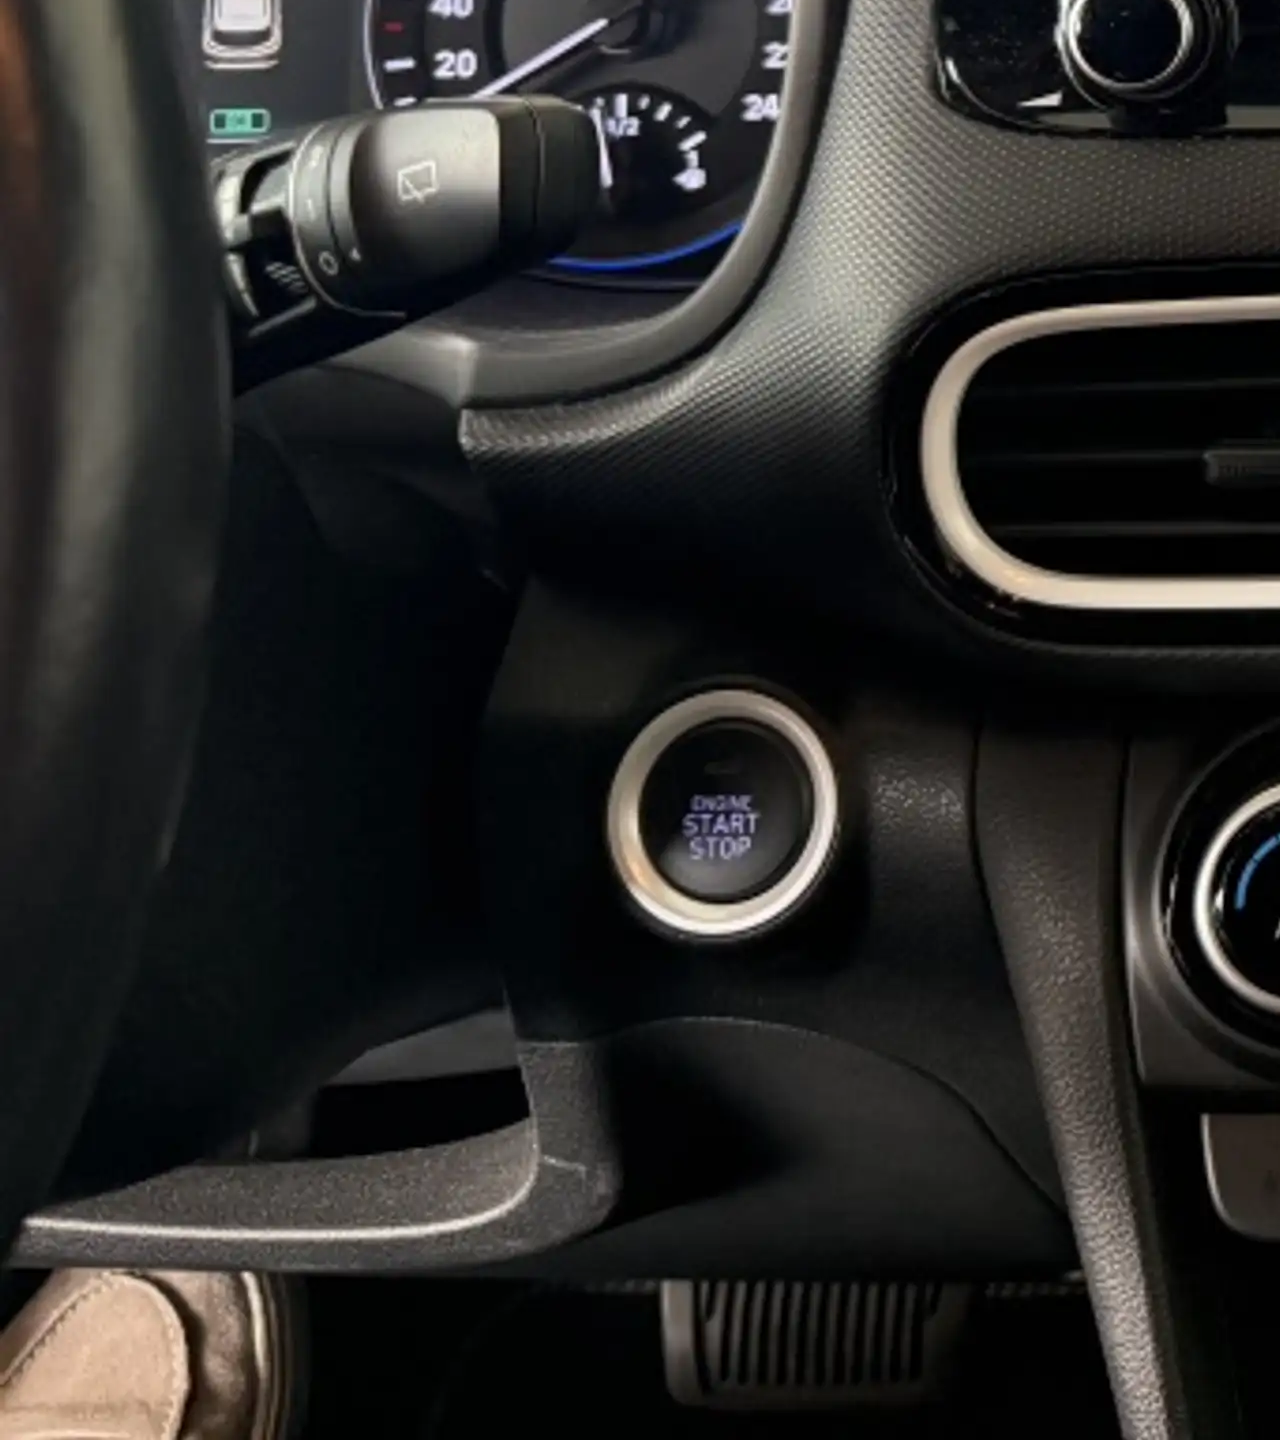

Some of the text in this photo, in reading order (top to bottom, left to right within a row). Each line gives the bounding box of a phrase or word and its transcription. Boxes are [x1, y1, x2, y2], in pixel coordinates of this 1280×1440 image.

[433, 50, 477, 78] 20
[691, 795, 752, 811] ENGINE
[682, 814, 759, 837] START
[690, 837, 752, 860] STOP
